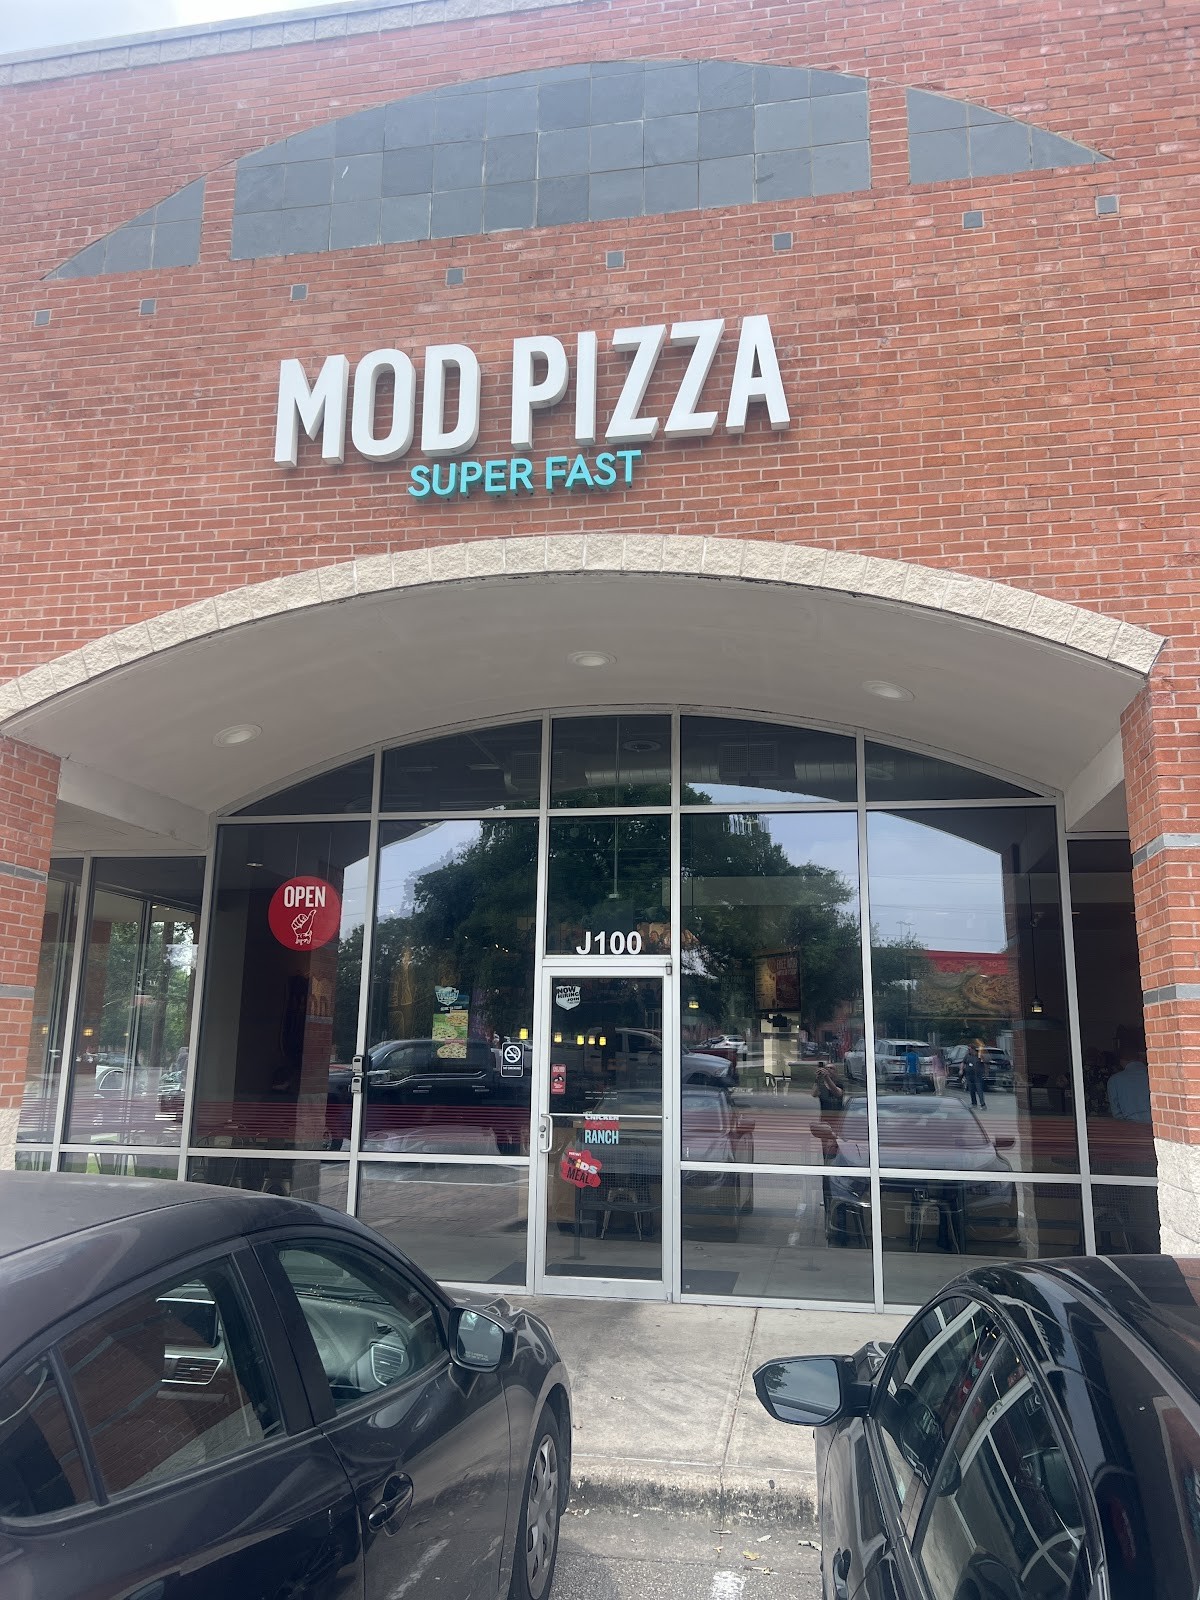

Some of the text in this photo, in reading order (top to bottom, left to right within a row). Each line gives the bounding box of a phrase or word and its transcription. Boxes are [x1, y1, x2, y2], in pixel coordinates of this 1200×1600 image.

[274, 314, 790, 467] MOD PIZZA
[408, 449, 642, 499] SUPER FAST
[284, 886, 326, 908] OPEN
[576, 931, 642, 955] J100
[557, 986, 576, 994] NOW
[585, 1129, 619, 1144] RANCH
[566, 1167, 590, 1184] MEAL
